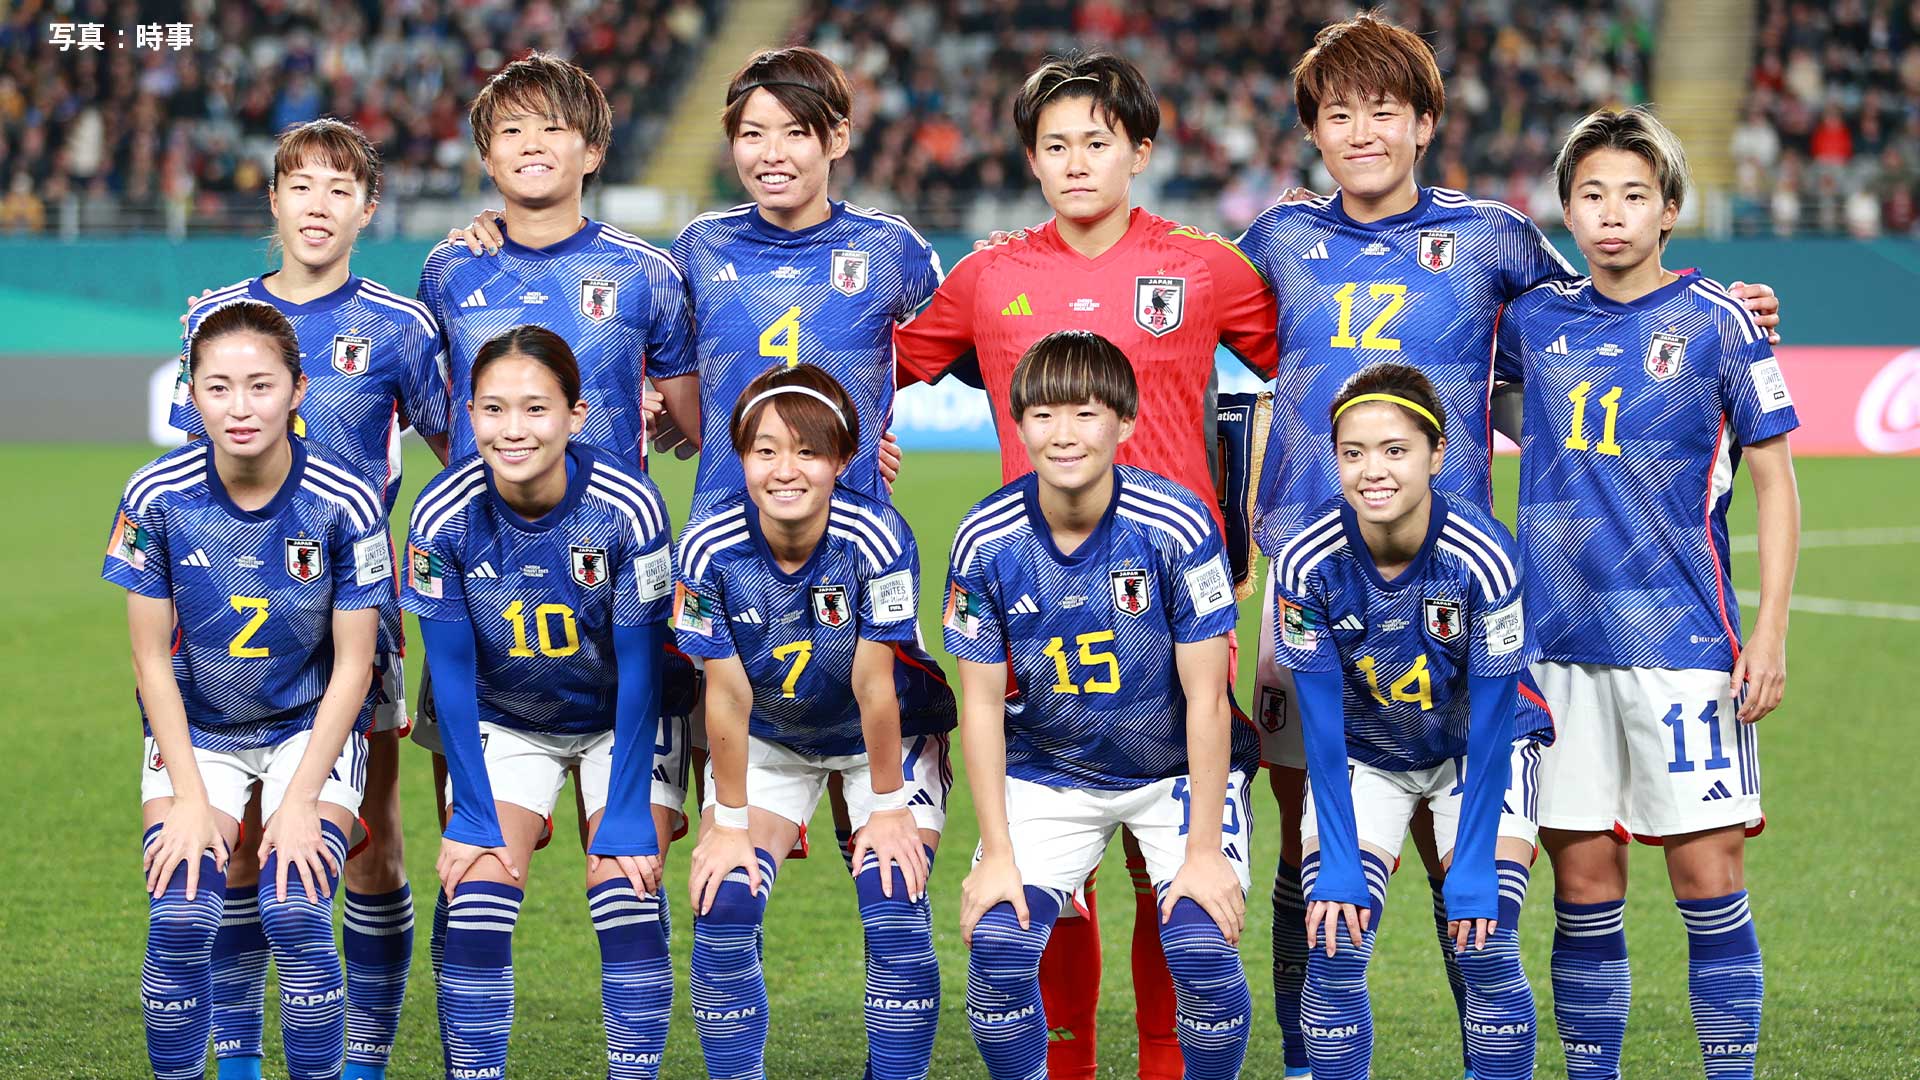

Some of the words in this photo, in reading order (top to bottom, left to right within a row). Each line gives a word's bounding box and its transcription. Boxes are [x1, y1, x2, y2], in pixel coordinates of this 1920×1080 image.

[1148, 315, 1168, 325] JFA
[1330, 282, 1408, 351] 12
[759, 306, 801, 367] 4
[1565, 381, 1623, 457] 11
[646, 561, 667, 577] UNITES
[1199, 572, 1221, 591] UNITES
[881, 586, 906, 598] UNITES
[229, 595, 270, 658] 2
[501, 600, 580, 658] 10
[772, 640, 813, 698] 7
[1042, 629, 1121, 695] 15
[1355, 654, 1434, 711] 14
[1661, 699, 1731, 773] 11
[141, 993, 197, 1011] APAN
[282, 987, 344, 1006] JAPAN
[865, 996, 934, 1010] JAPAN
[967, 1004, 1035, 1024] JAPAN
[1176, 1013, 1244, 1032] JAPAN
[1464, 1022, 1530, 1035] JAPAN
[214, 1039, 241, 1052] PAN
[347, 1041, 394, 1054] JAPAN
[1562, 1041, 1602, 1055] PAN
